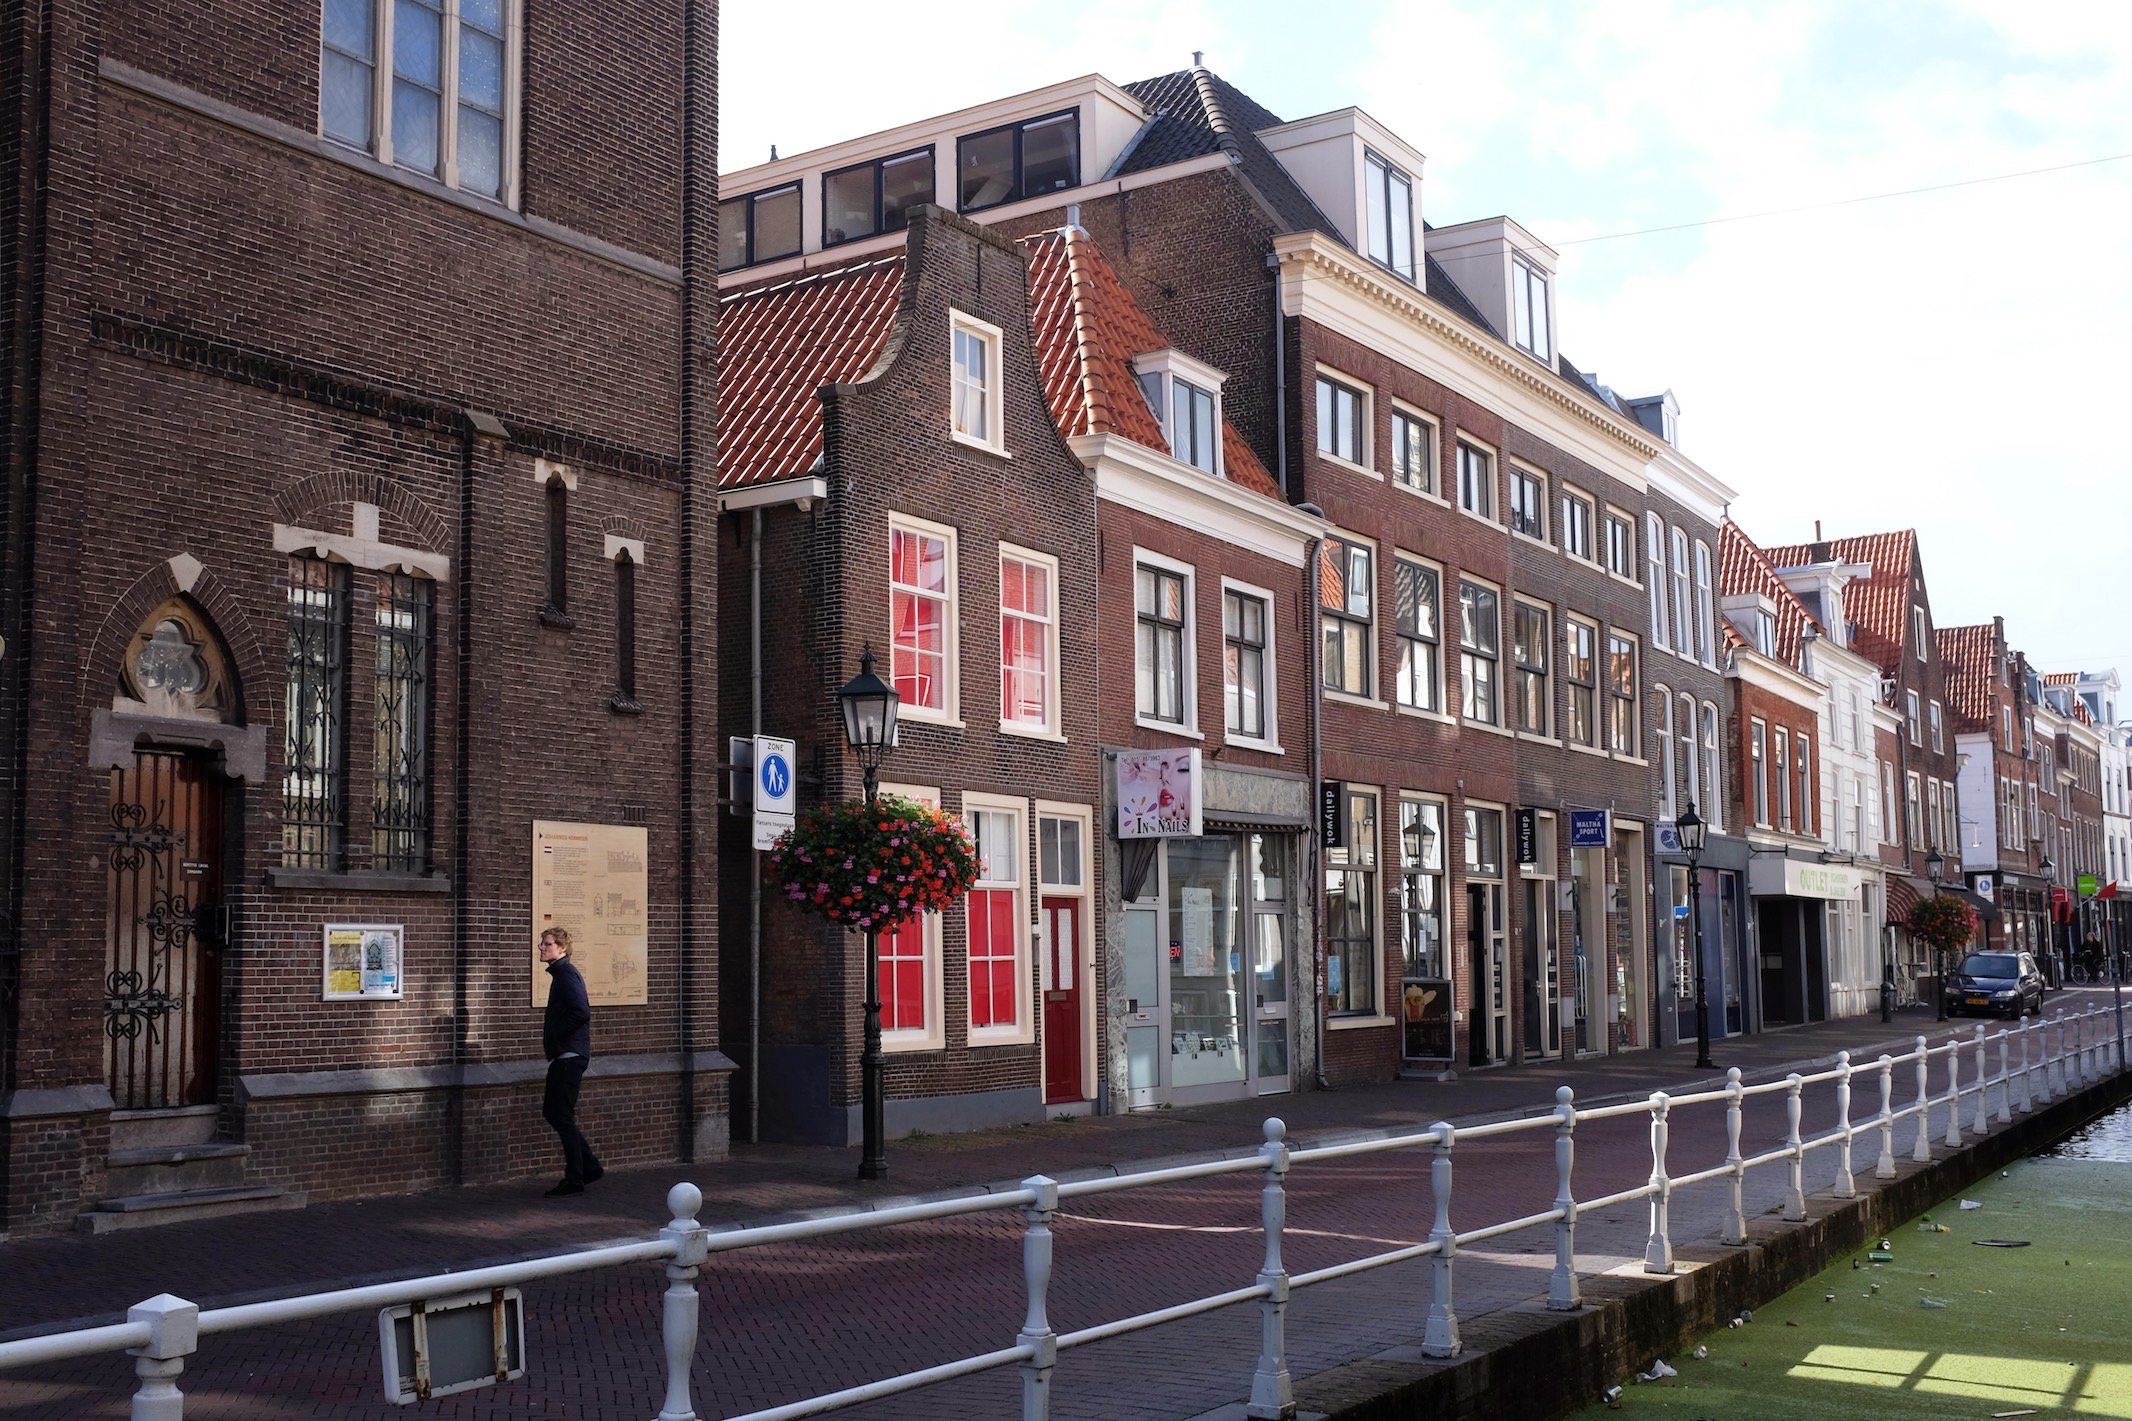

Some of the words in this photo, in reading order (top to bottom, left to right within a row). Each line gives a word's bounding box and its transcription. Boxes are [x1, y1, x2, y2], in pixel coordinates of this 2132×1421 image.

[767, 742, 784, 752] ZONE
[1158, 817, 1189, 833] NAILS
[1325, 790, 1336, 845] dailywok
[1576, 821, 1601, 829] MALTHA
[1521, 815, 1531, 861] dailywok
[1579, 828, 1598, 836] SPORT
[1800, 868, 1829, 892] OUTLET
